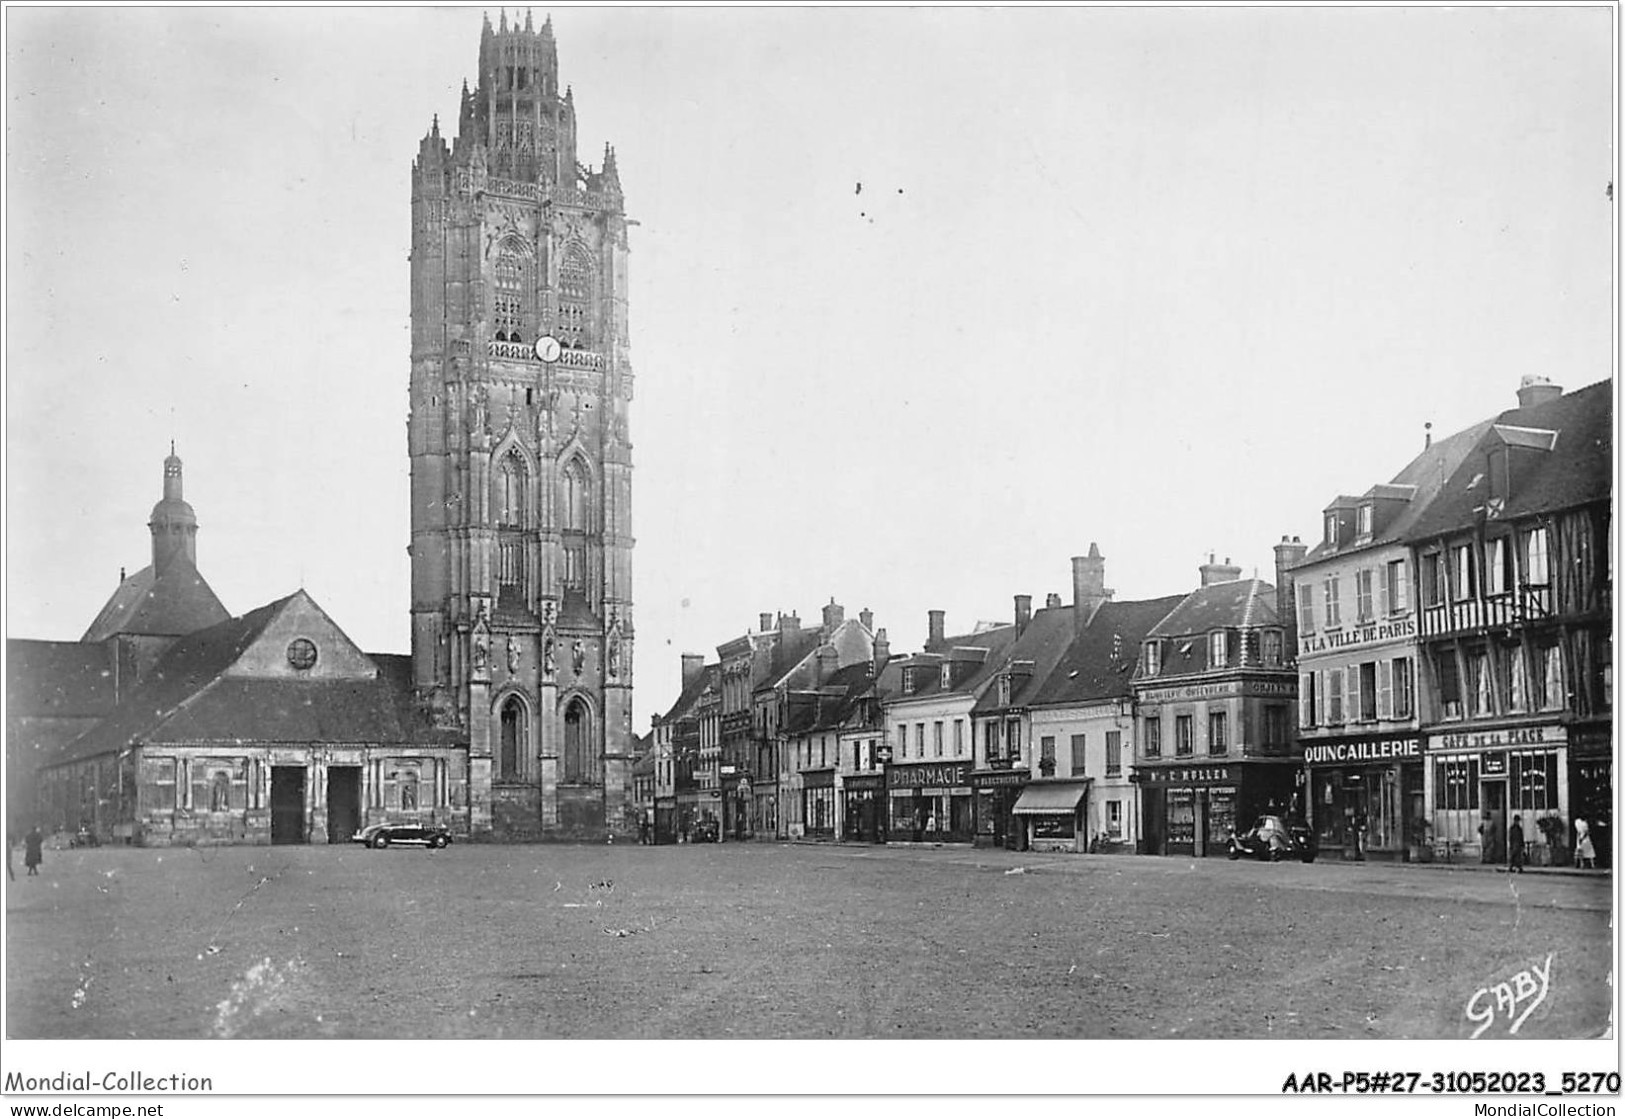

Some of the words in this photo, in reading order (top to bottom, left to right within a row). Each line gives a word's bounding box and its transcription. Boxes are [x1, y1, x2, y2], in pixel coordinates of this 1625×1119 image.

[1302, 640, 1310, 653] A
[1312, 637, 1326, 652] LA
[1328, 630, 1361, 648] VILLE
[1363, 627, 1377, 643] DE
[1378, 620, 1415, 640] PARIS
[1507, 728, 1544, 743] PLACE
[1304, 738, 1419, 763] QUINCAILLERIE
[893, 765, 967, 785] PHARMACIE
